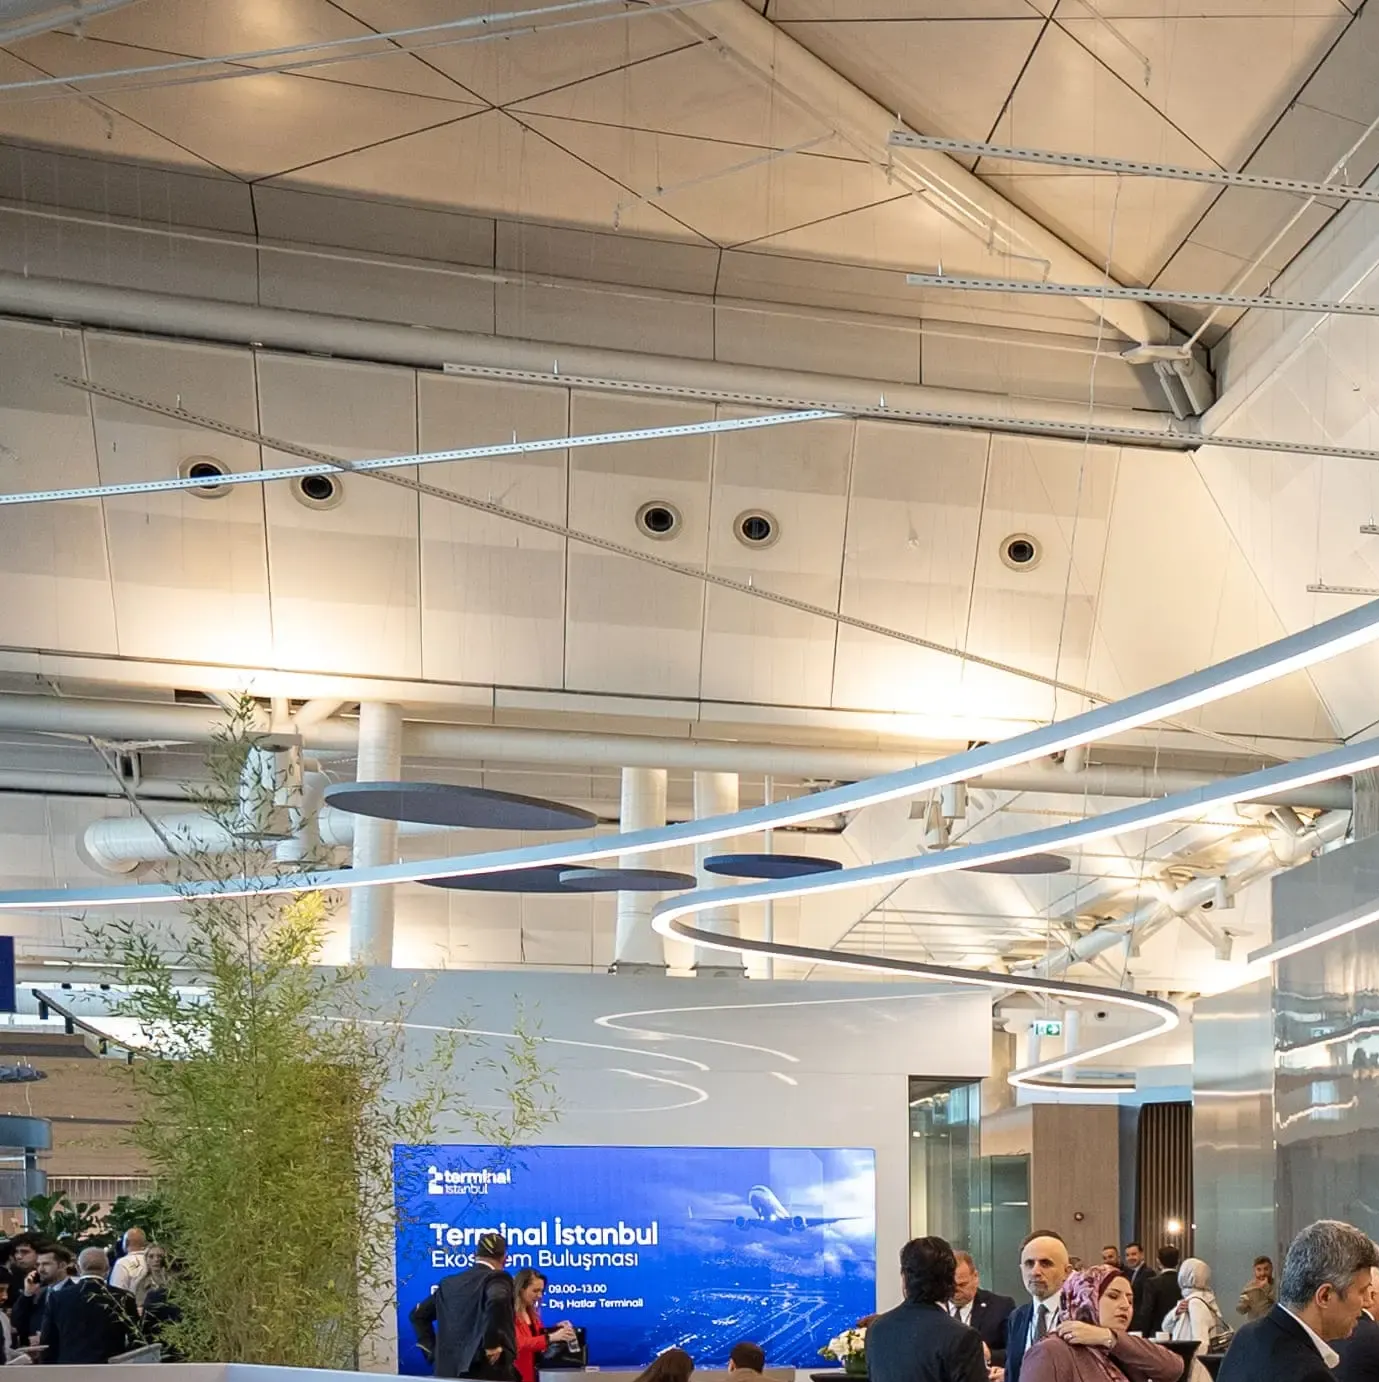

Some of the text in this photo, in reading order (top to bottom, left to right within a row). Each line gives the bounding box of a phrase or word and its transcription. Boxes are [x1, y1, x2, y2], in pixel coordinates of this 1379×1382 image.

[444, 1168, 511, 1185] terminal
[554, 1216, 658, 1246] İstanbul
[432, 1248, 639, 1271] Ekosem Buluşması
[549, 1299, 564, 1310] Dış
[566, 1299, 597, 1309] Hatlar
[599, 1298, 644, 1308] Terminali
